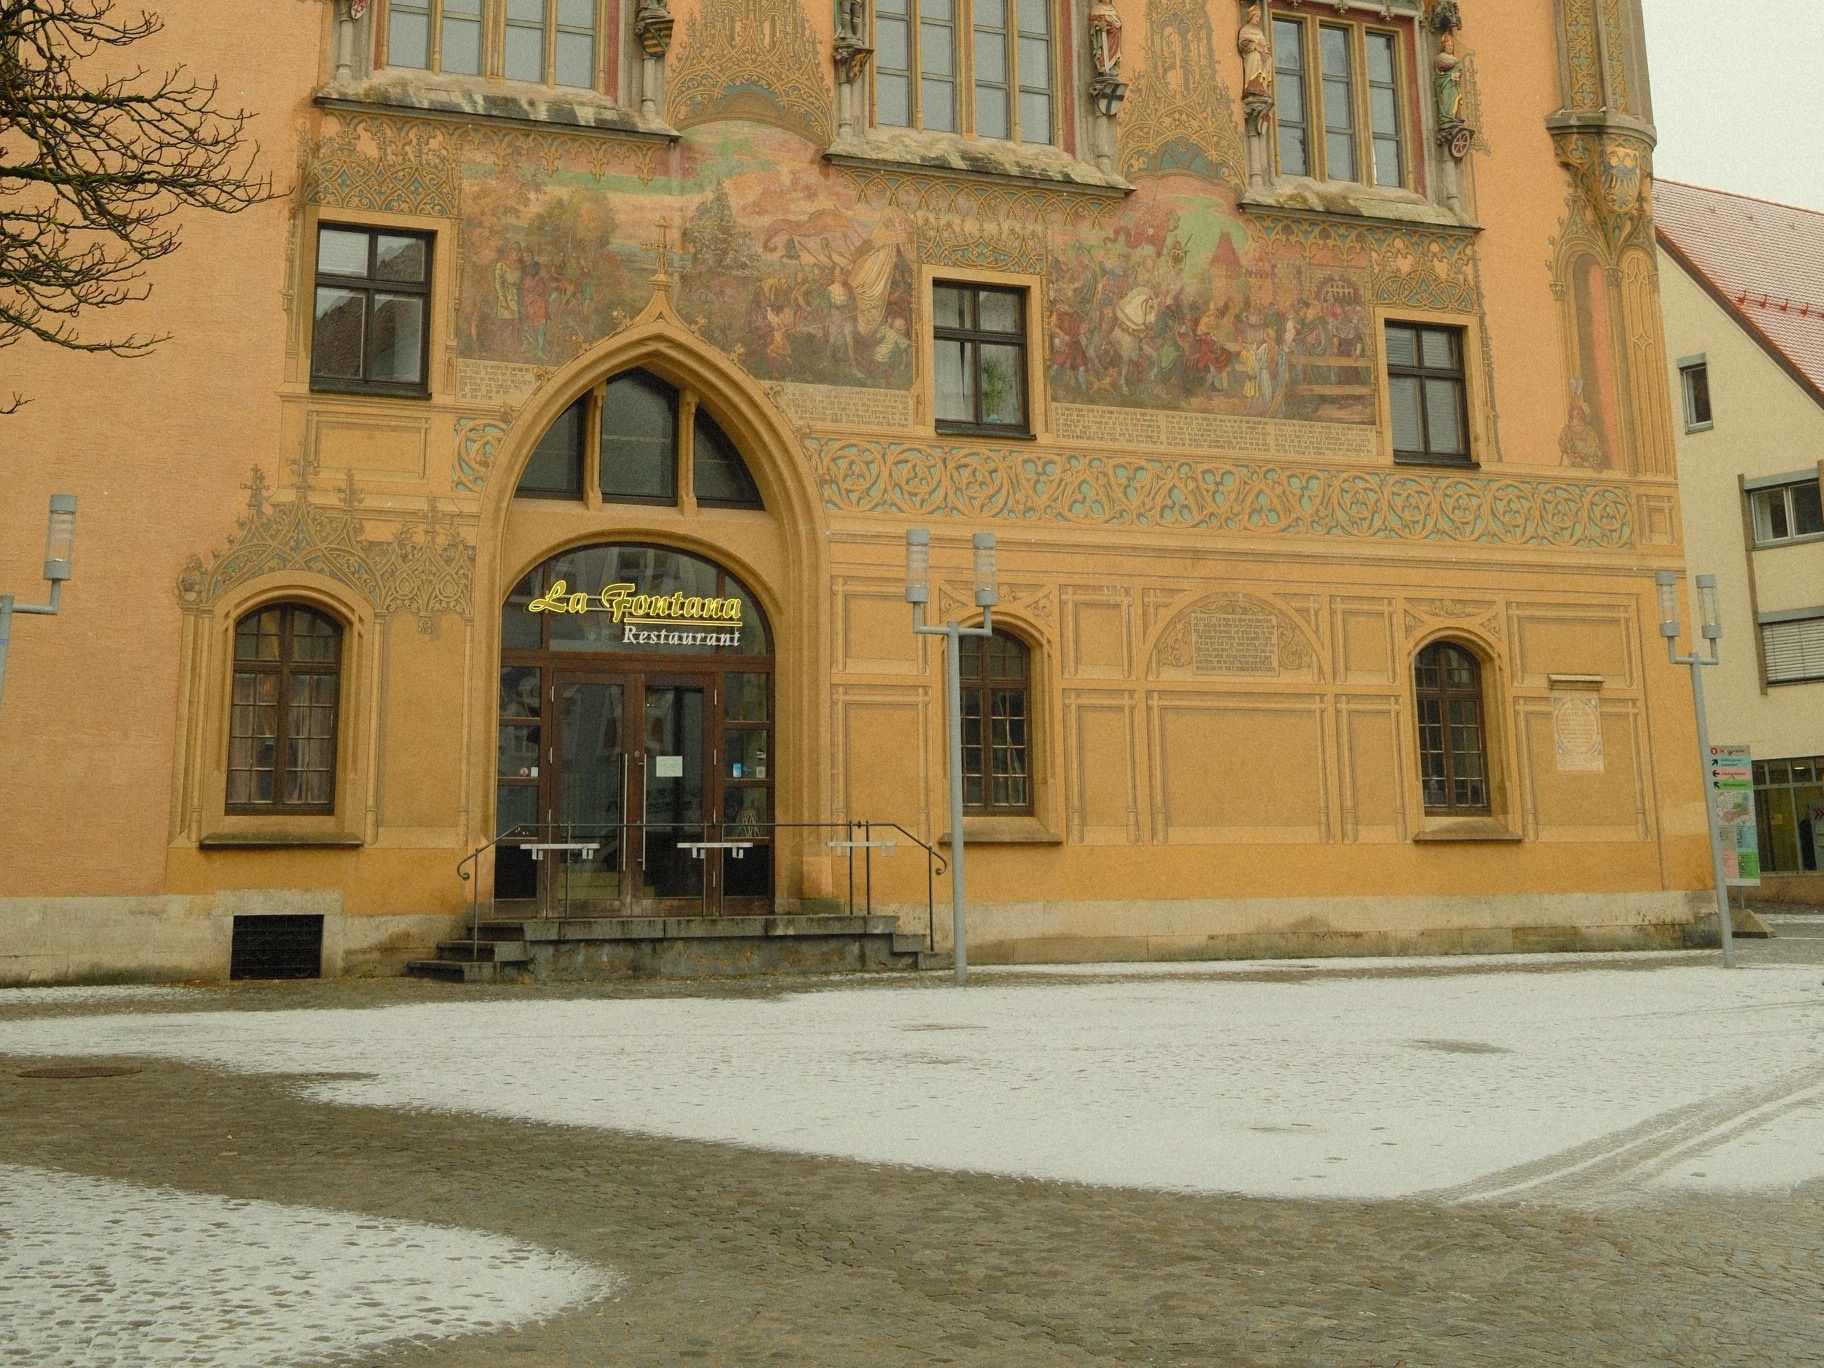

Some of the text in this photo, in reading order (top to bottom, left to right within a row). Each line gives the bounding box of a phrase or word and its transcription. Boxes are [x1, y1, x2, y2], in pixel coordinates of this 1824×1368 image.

[528, 580, 743, 623] La Fontana
[622, 625, 742, 648] Restaurant
